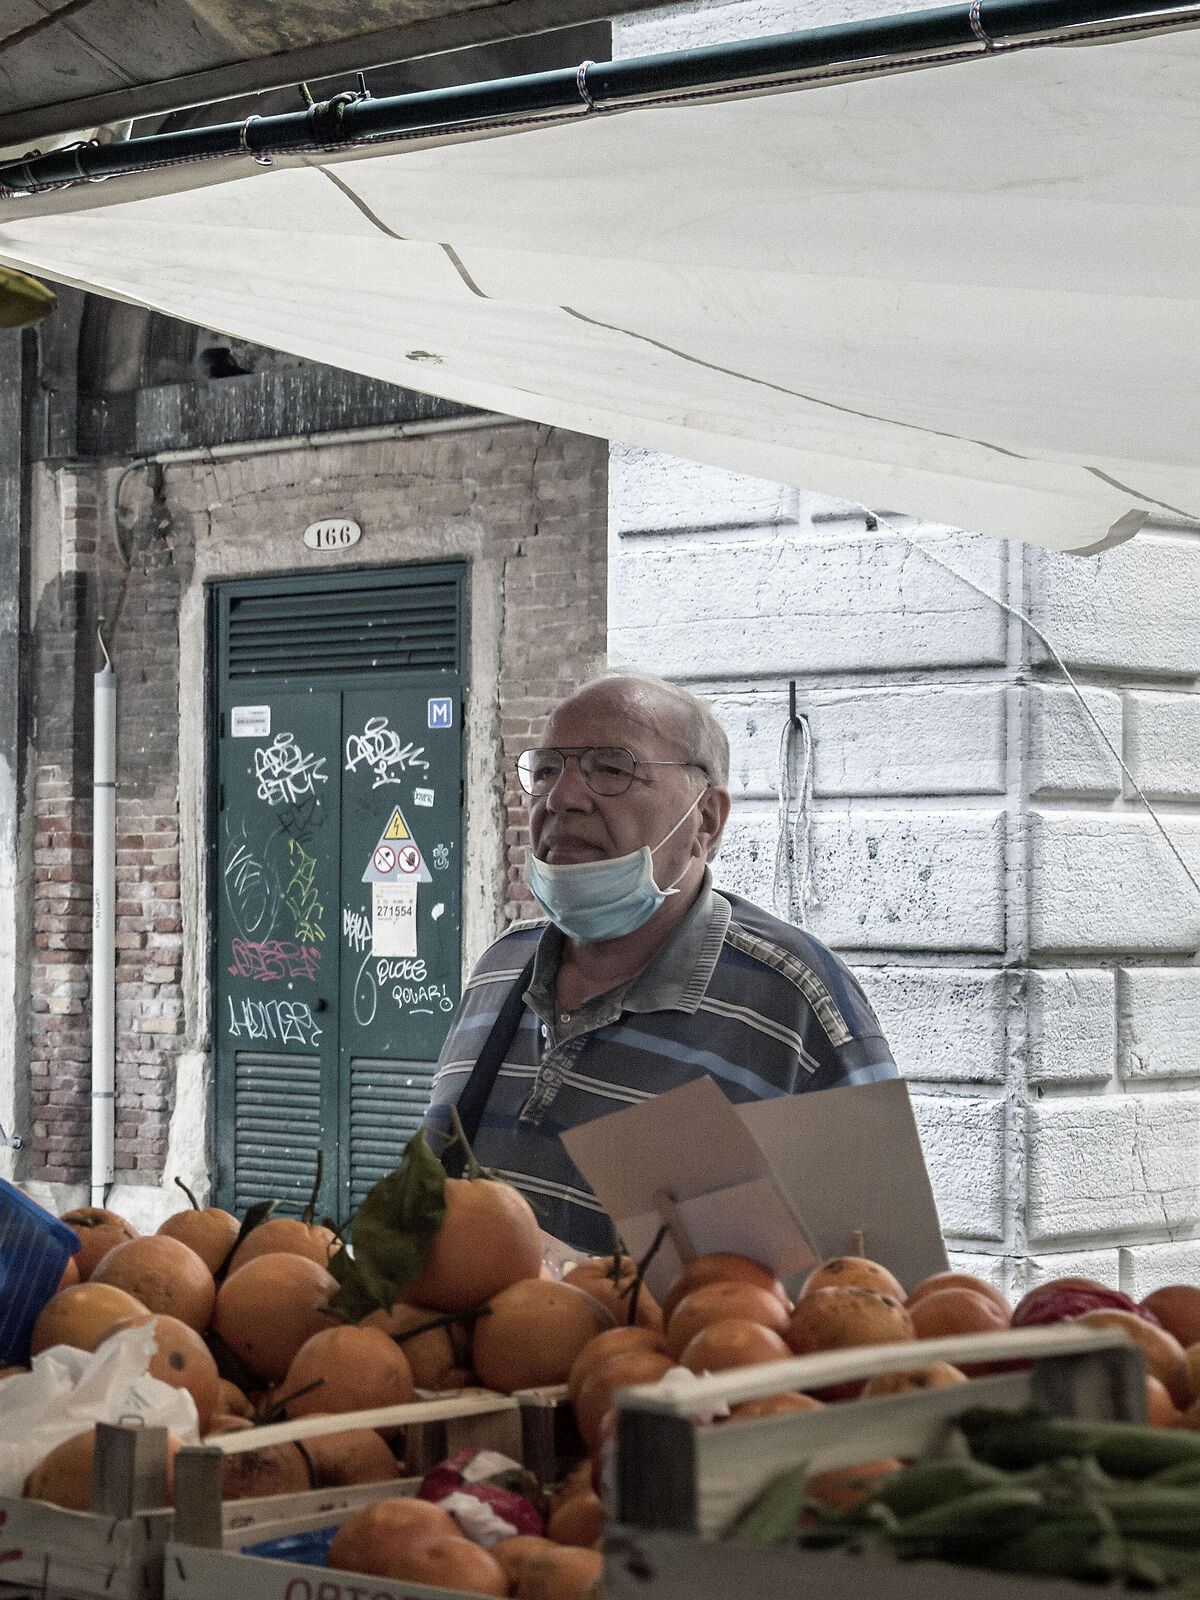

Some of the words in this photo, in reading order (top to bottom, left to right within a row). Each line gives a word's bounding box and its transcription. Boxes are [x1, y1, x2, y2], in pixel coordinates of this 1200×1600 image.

[314, 526, 351, 548] 166
[432, 704, 448, 723] M
[377, 905, 413, 917] 271554
